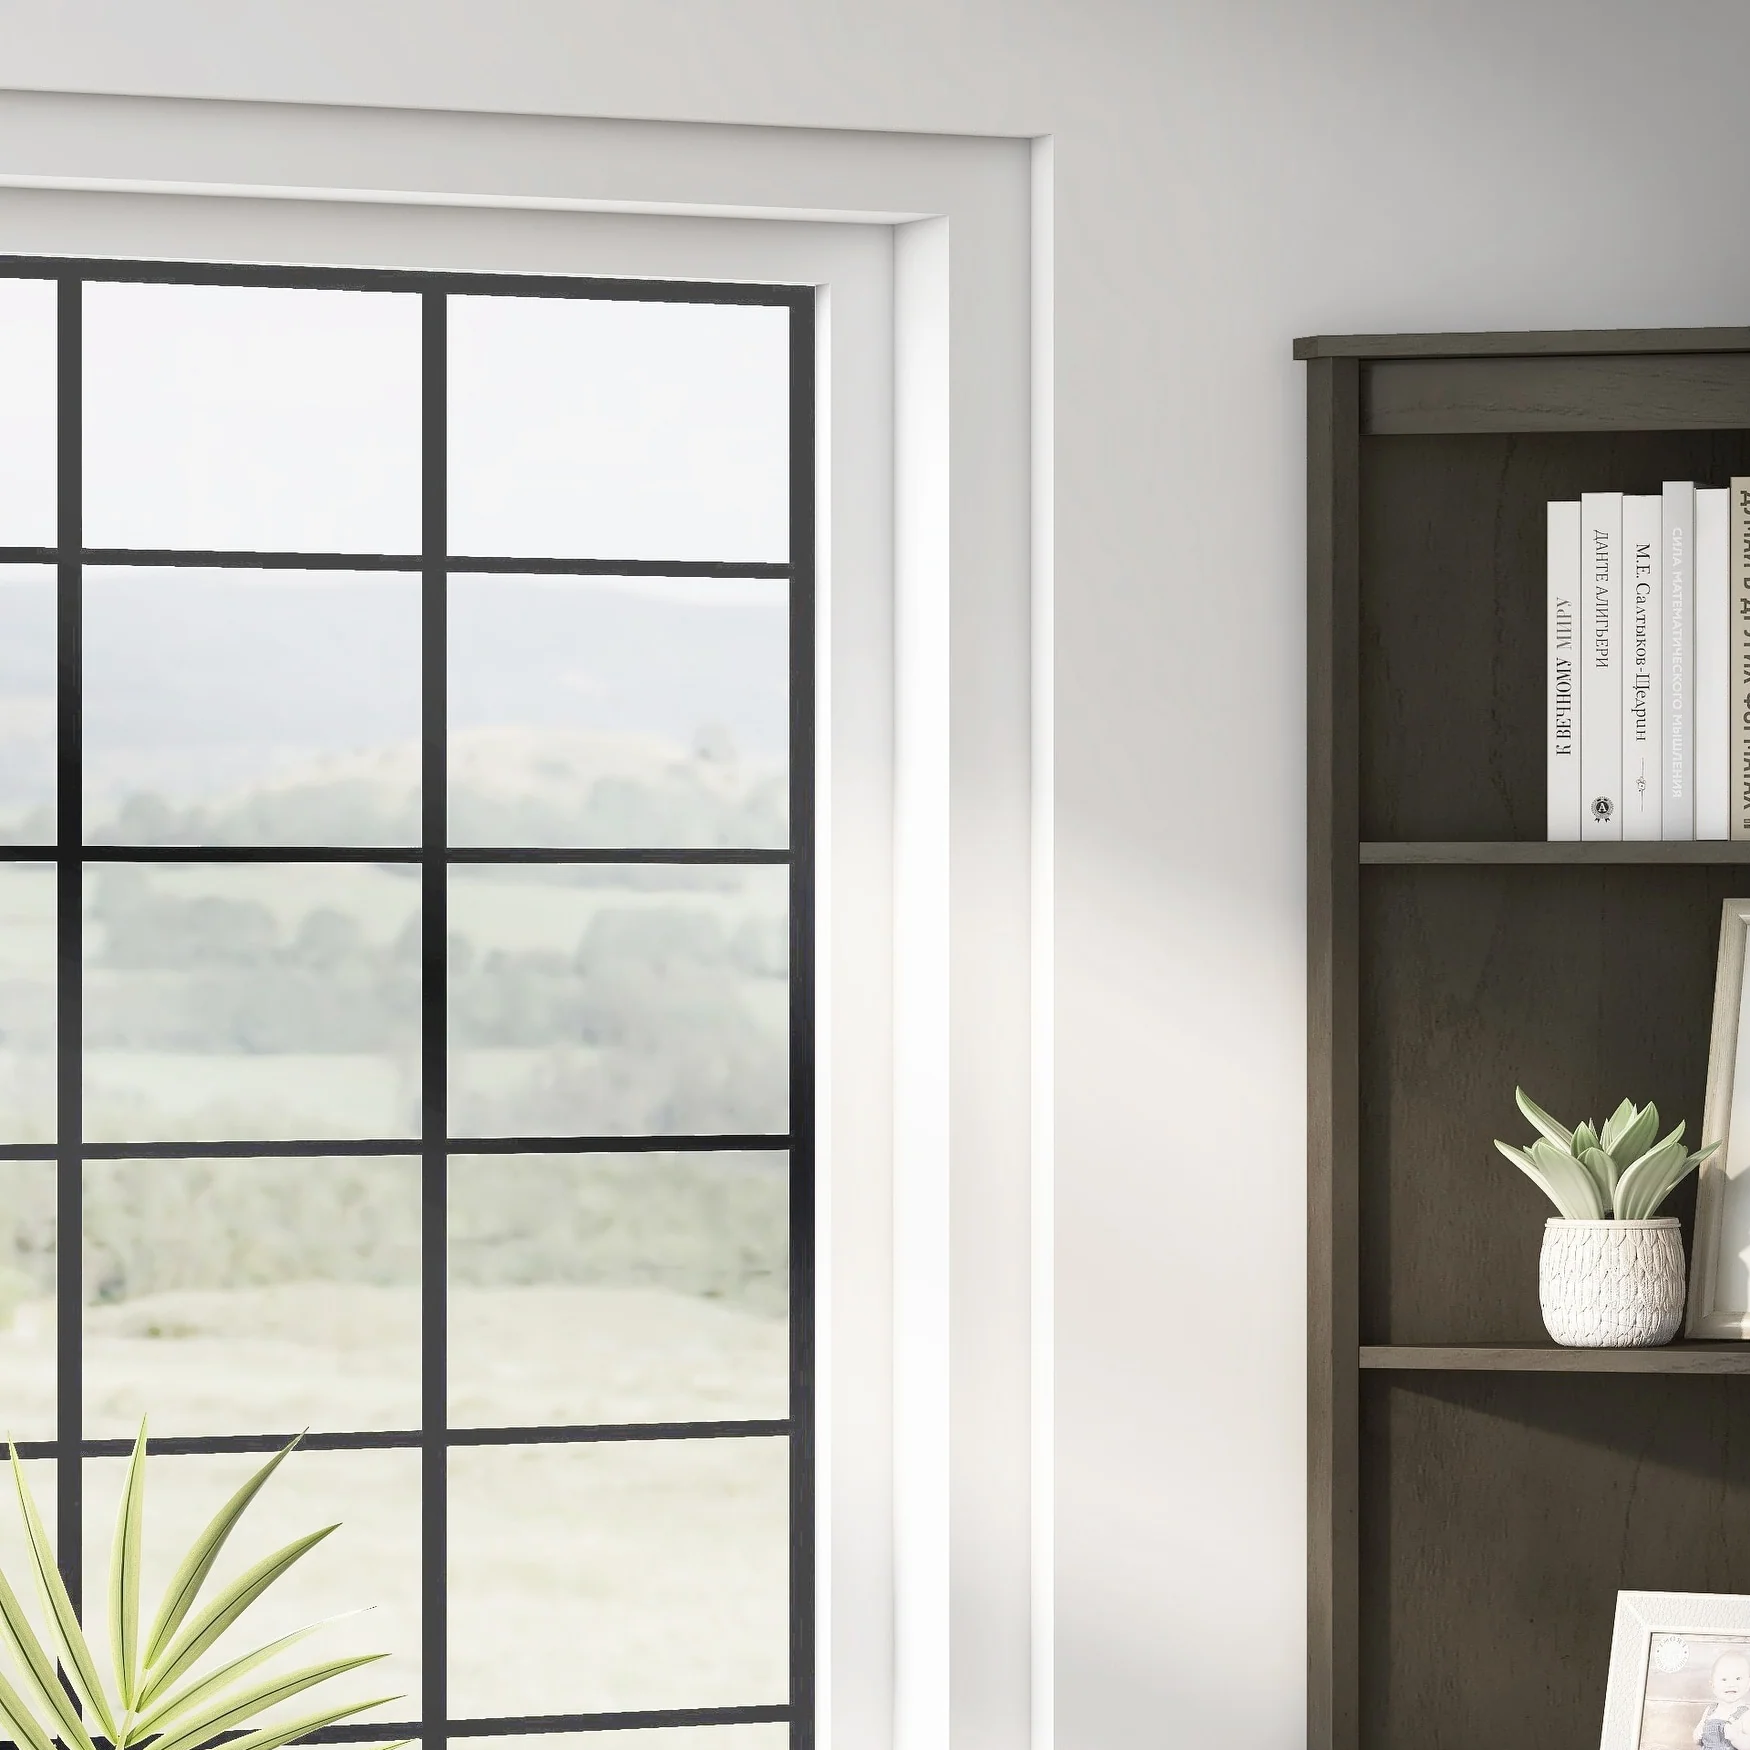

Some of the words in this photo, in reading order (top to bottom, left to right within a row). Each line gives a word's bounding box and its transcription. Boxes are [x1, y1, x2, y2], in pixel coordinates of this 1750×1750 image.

[1593, 530, 1609, 582] ДАНТЕ
[1635, 543, 1651, 579] М.Е.
[1672, 527, 1683, 567] СИЛА
[1555, 596, 1572, 650] МИРУ
[1595, 586, 1609, 668] АЛИГЬЕРИ
[1672, 571, 1683, 710] МАТЕМАТИЧЕСКОГО
[1631, 582, 1651, 741] Салтыков-Щедрин
[1555, 657, 1572, 739] ВЕЧНОМУ
[1555, 744, 1572, 755] К
[1672, 714, 1683, 798] МЫШЛЕНИЯ
